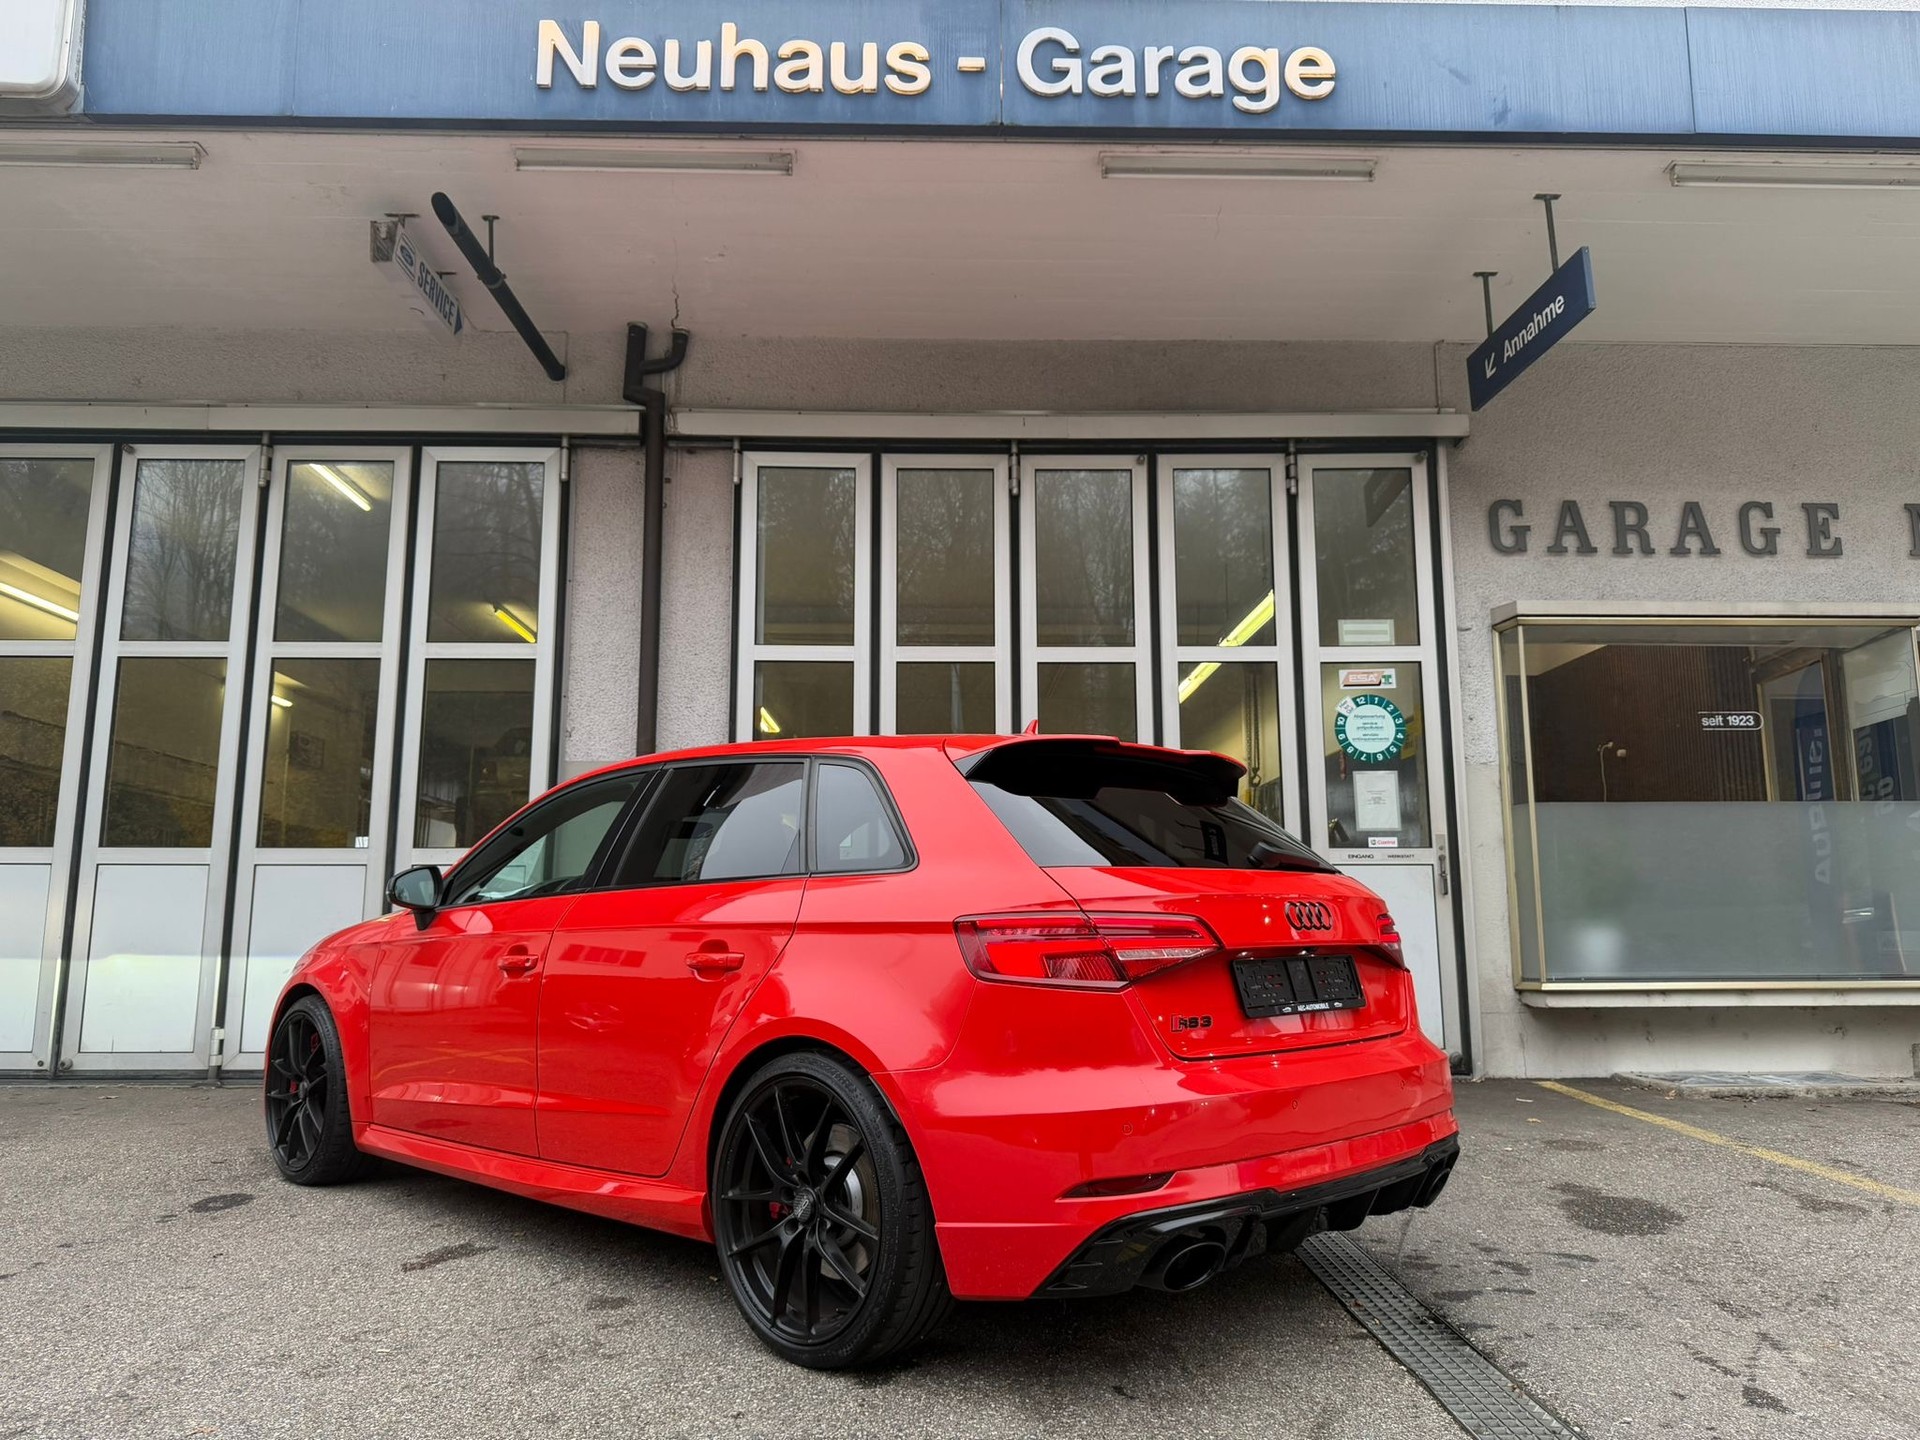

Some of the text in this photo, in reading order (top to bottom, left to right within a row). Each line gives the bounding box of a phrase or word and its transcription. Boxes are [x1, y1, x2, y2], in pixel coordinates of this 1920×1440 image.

[535, 19, 1336, 115] Neuhaus - Garage
[417, 261, 456, 327] SERVICE
[1503, 294, 1565, 364] Annahme
[1487, 499, 1843, 557] GARAGE
[1356, 696, 1366, 705] 12
[1386, 704, 1394, 712] 2
[1337, 716, 1346, 725] 10
[1701, 714, 1755, 726] seit 1923
[1389, 745, 1397, 753] 5
[1376, 753, 1383, 761] 6
